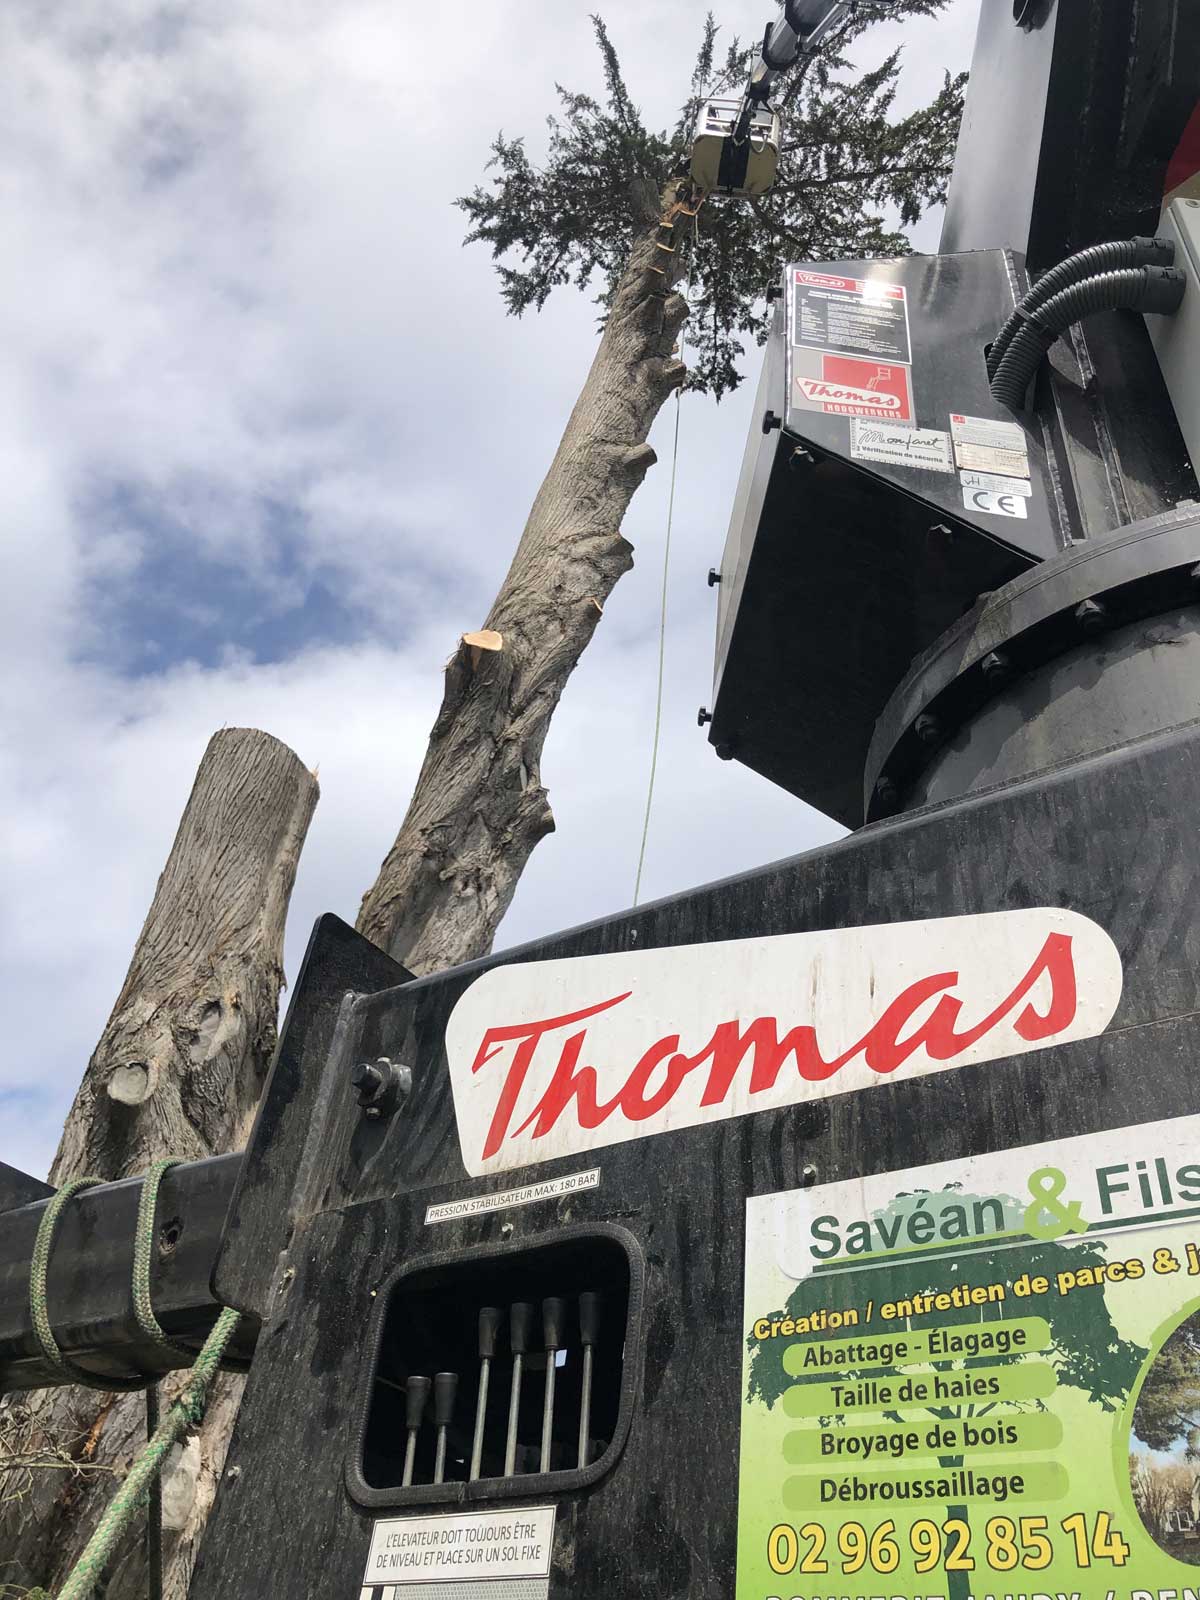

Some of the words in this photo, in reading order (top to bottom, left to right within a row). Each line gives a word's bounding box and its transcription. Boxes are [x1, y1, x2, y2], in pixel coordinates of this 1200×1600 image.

[804, 380, 896, 406] Thomas
[826, 404, 902, 418] HOOGWERKERS
[862, 446, 904, 458] Vérification
[914, 454, 944, 464] sécurité
[472, 932, 1077, 1161] Thomas
[429, 1205, 468, 1220] PRESSION
[470, 1190, 532, 1211] STABILISATEUR
[534, 1184, 558, 1197] MAX:
[559, 1180, 576, 1191] 180
[577, 1173, 596, 1187] BAR
[809, 1198, 1005, 1260] Savéan
[1023, 1167, 1089, 1240] &
[1096, 1157, 1200, 1215] Fils
[752, 1308, 860, 1341] Création
[864, 1299, 874, 1324] /
[879, 1282, 1006, 1321] entretien
[1012, 1273, 1050, 1298] de
[1057, 1258, 1146, 1296] parcs
[1152, 1247, 1181, 1275] &
[1184, 1242, 1200, 1276] j
[804, 1340, 908, 1369] Abattage
[928, 1327, 1026, 1357] Élagage
[831, 1379, 892, 1408] Taille
[897, 1381, 928, 1403] de
[934, 1373, 1001, 1400] haies
[820, 1429, 919, 1460] Broyage
[924, 1427, 957, 1451] de
[963, 1419, 1018, 1446] bois
[820, 1470, 1025, 1503] Débroussaillage
[440, 1529, 463, 1544] DOIT
[513, 1520, 537, 1539] ÊTRE
[767, 1522, 829, 1575] 02
[836, 1519, 901, 1575] 96
[909, 1518, 976, 1575] 92
[984, 1514, 1054, 1572] 85
[1060, 1511, 1131, 1569] 14
[376, 1554, 389, 1569] DE
[389, 1551, 422, 1568] NIVEAU
[423, 1551, 436, 1566] ET
[436, 1548, 464, 1565] PLACE
[464, 1549, 484, 1563] SUR
[485, 1548, 500, 1562] UN
[501, 1545, 520, 1560] SOL
[521, 1543, 542, 1560] FIXE
